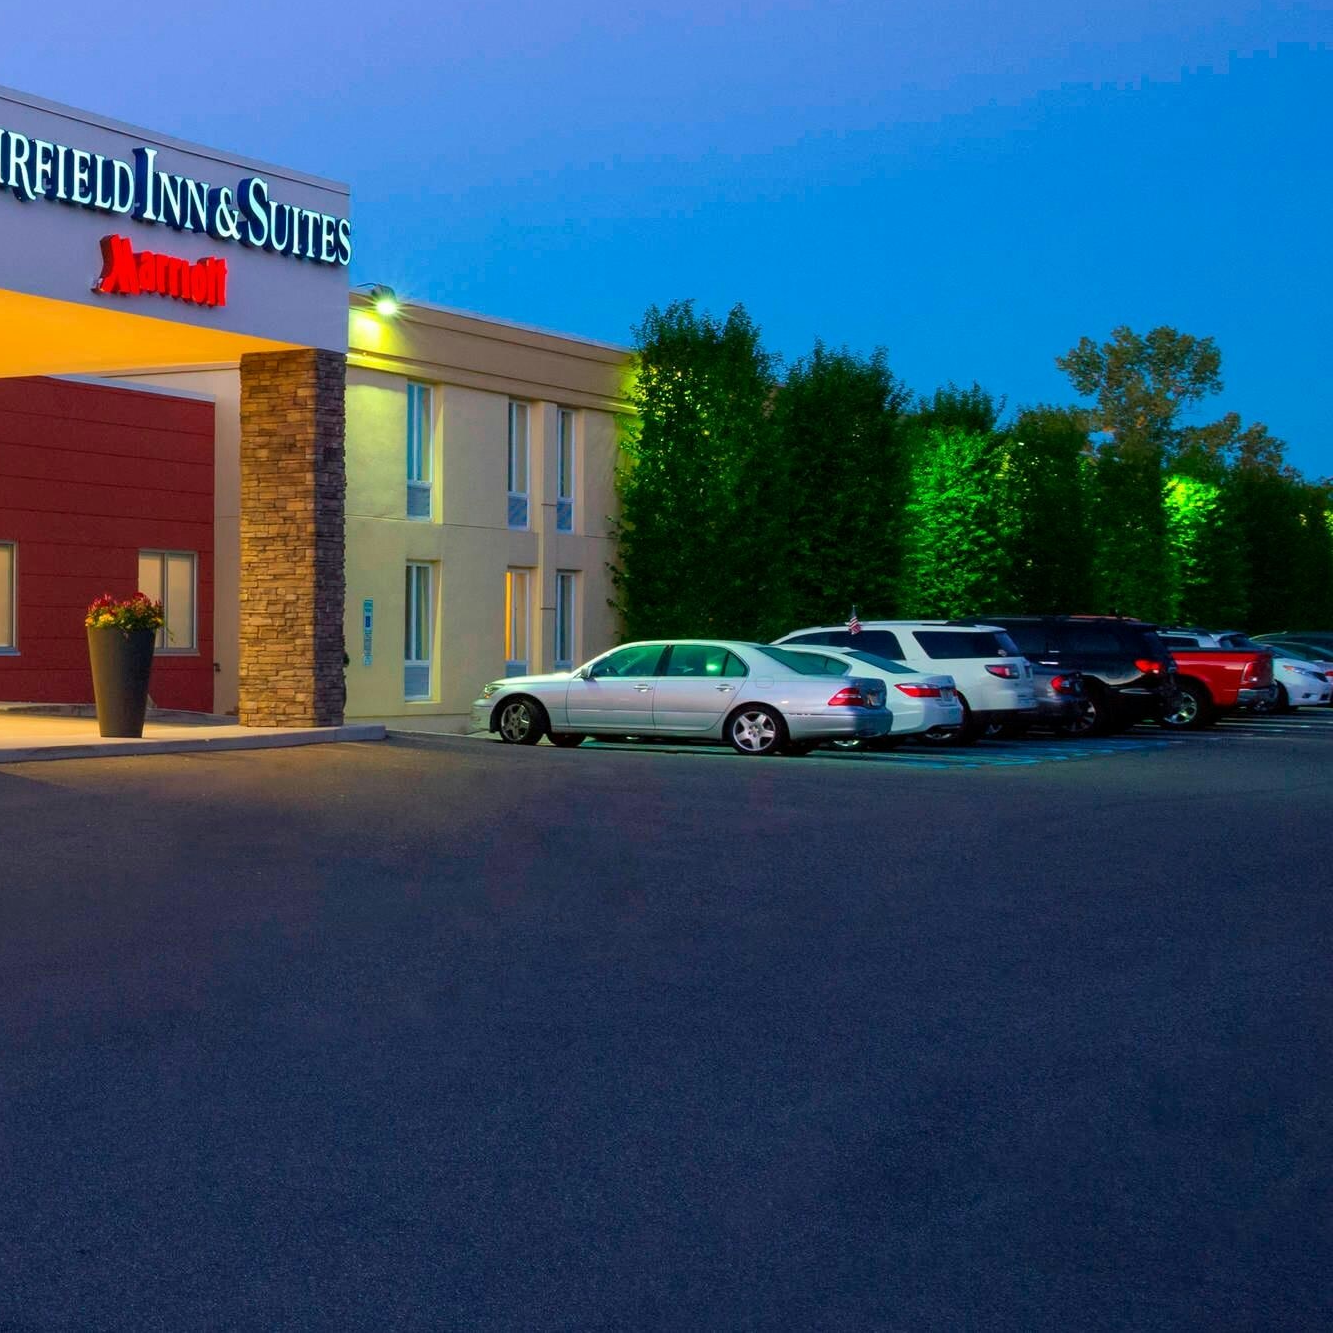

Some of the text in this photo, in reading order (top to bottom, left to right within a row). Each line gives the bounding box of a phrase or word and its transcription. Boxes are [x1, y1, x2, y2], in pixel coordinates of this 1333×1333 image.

[142, 147, 210, 232] INN
[214, 186, 242, 240] &
[247, 177, 351, 267] SUITES
[99, 234, 228, 307] Marriott
